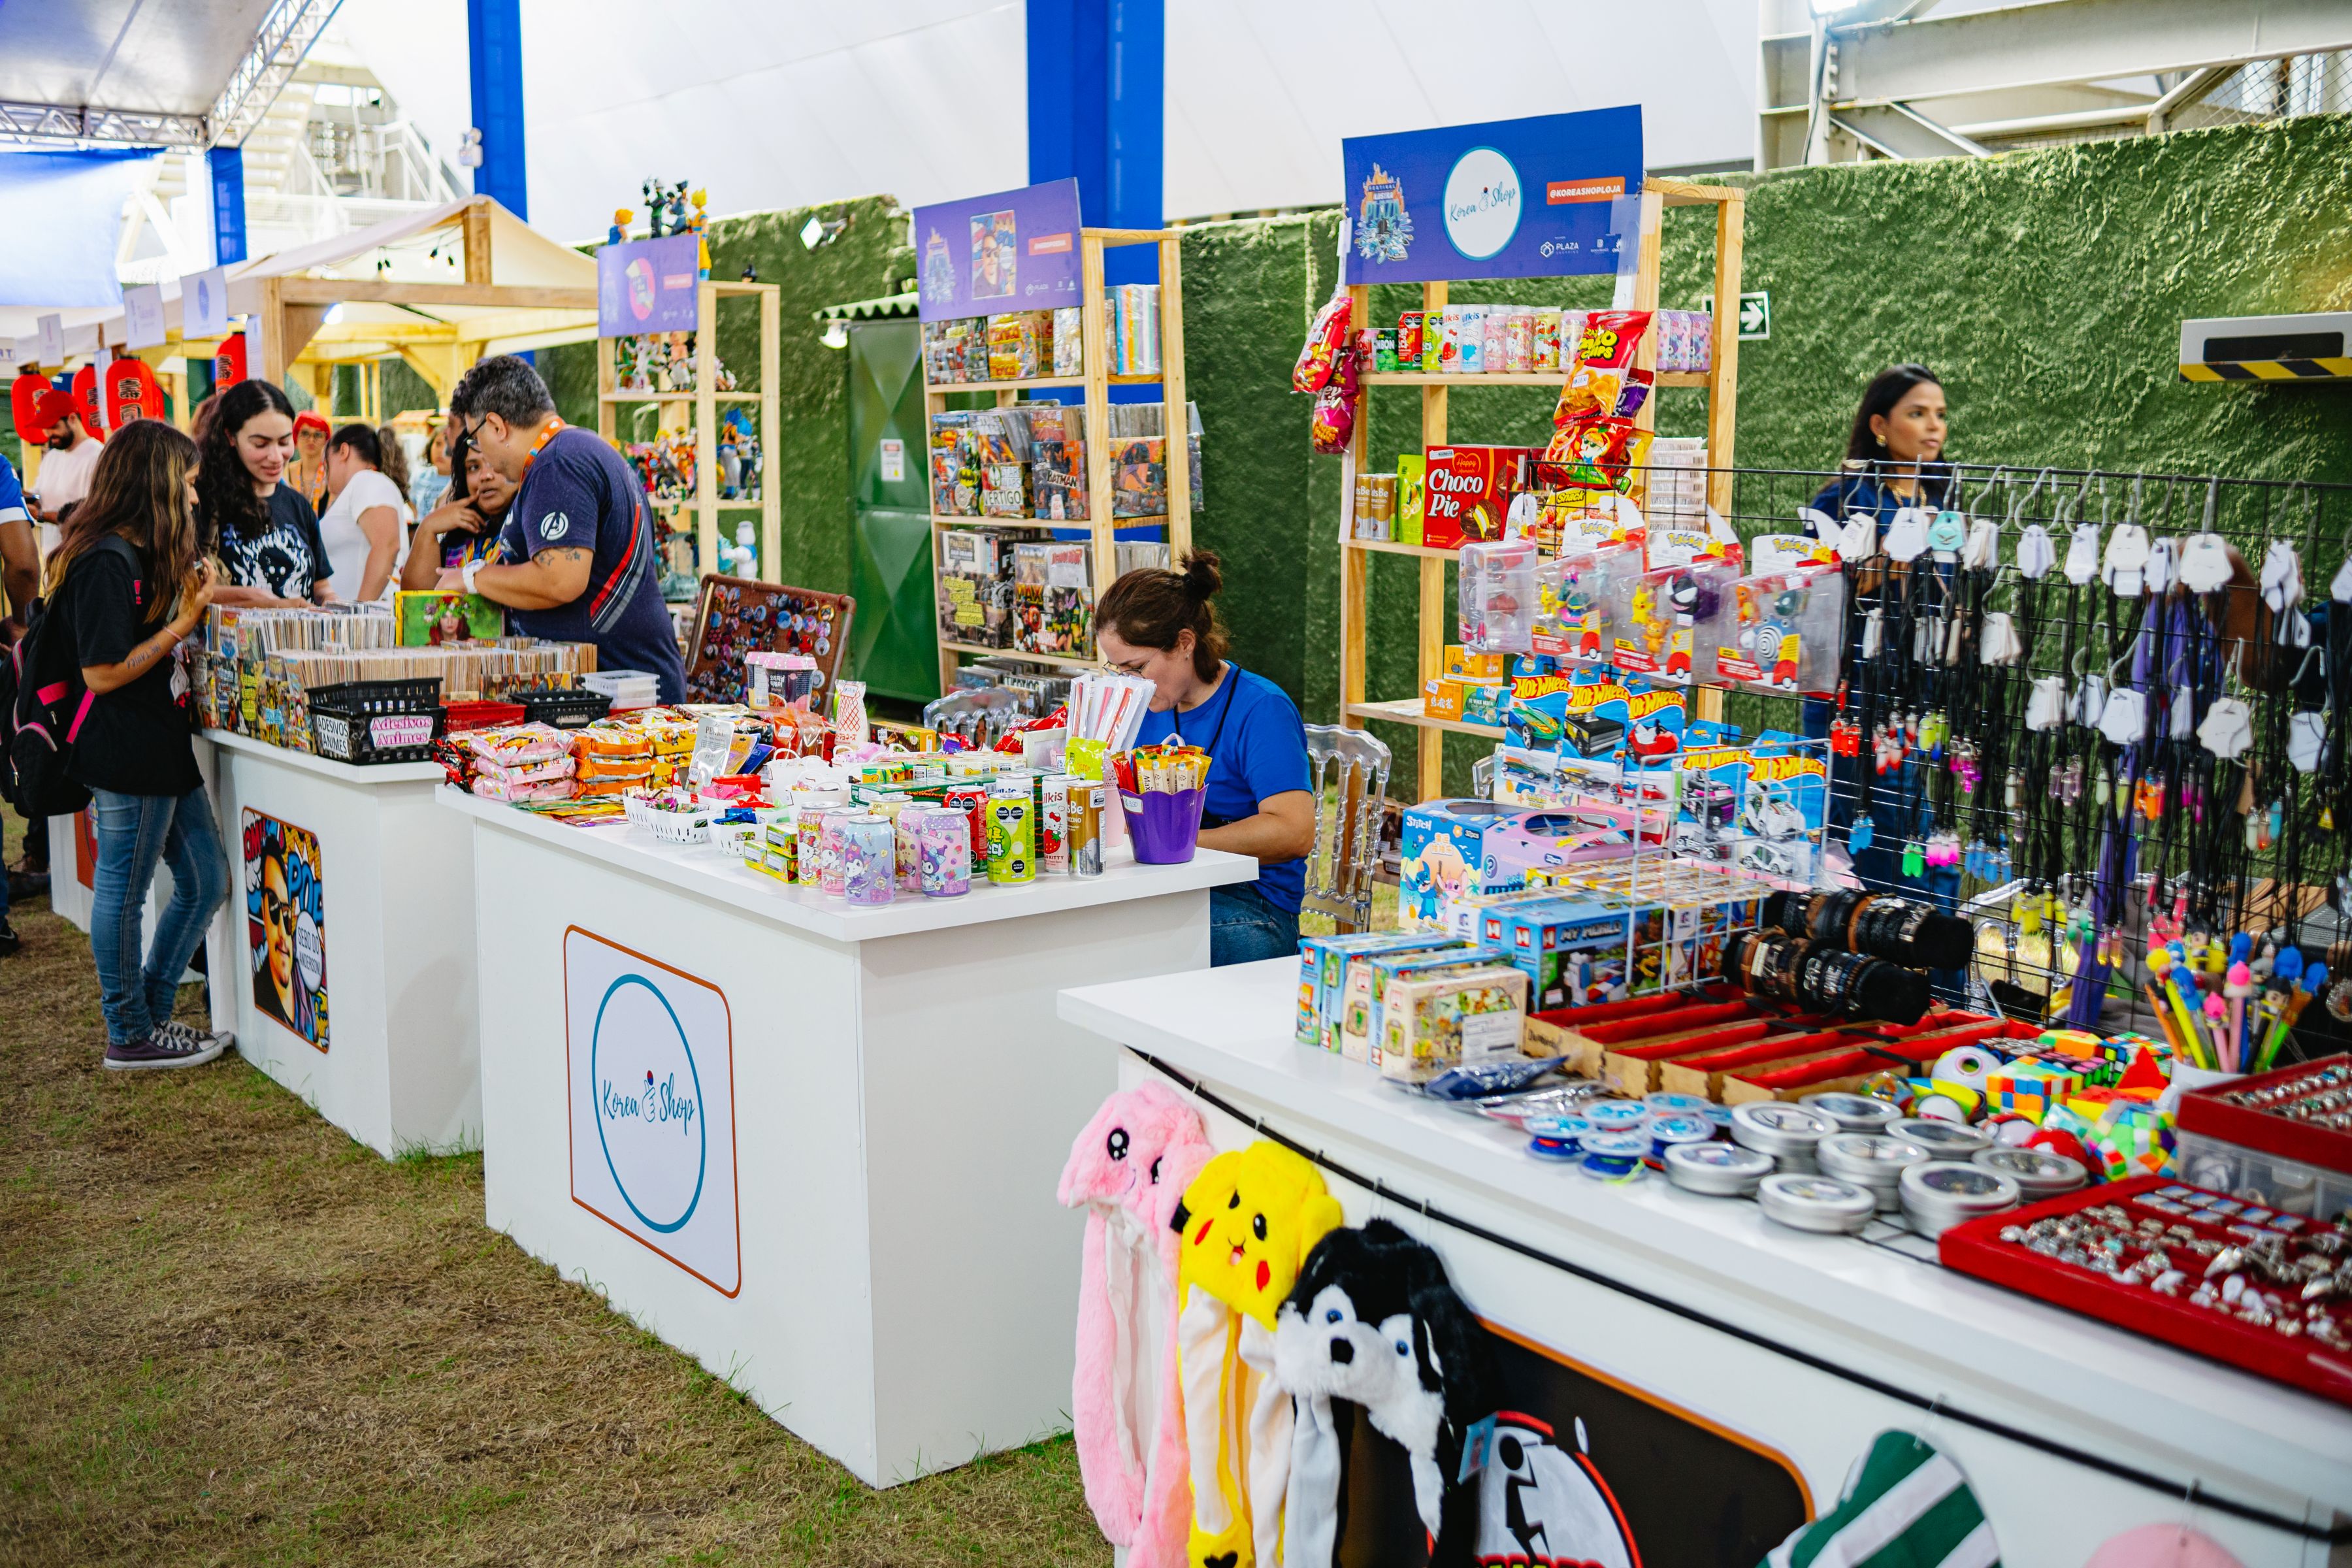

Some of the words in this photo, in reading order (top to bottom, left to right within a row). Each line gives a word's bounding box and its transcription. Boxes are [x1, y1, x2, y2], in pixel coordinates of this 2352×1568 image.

[1550, 185, 1621, 199] @KOREASHOPLOJA
[1450, 203, 1477, 221] Korea
[1491, 181, 1516, 207] Shop
[1556, 242, 1579, 250] PLAZA
[1456, 458, 1477, 467] Happy
[1047, 470, 1077, 487] BATMAN
[1428, 468, 1484, 494] Choco
[983, 490, 1022, 506] VERTIGO
[1427, 494, 1460, 518] Pie
[1556, 491, 1586, 504] Snack
[318, 715, 348, 737] ADESIVOS
[371, 714, 432, 731] Adesivos
[323, 733, 348, 754] ANIMES
[376, 731, 429, 745] Animes
[1043, 791, 1063, 804] ilkis
[1067, 800, 1083, 815] sBe
[243, 818, 266, 862] OM
[298, 926, 311, 950] SEBO
[312, 933, 319, 955] DO
[602, 1079, 640, 1120] Korea
[660, 1072, 695, 1136] Shop
